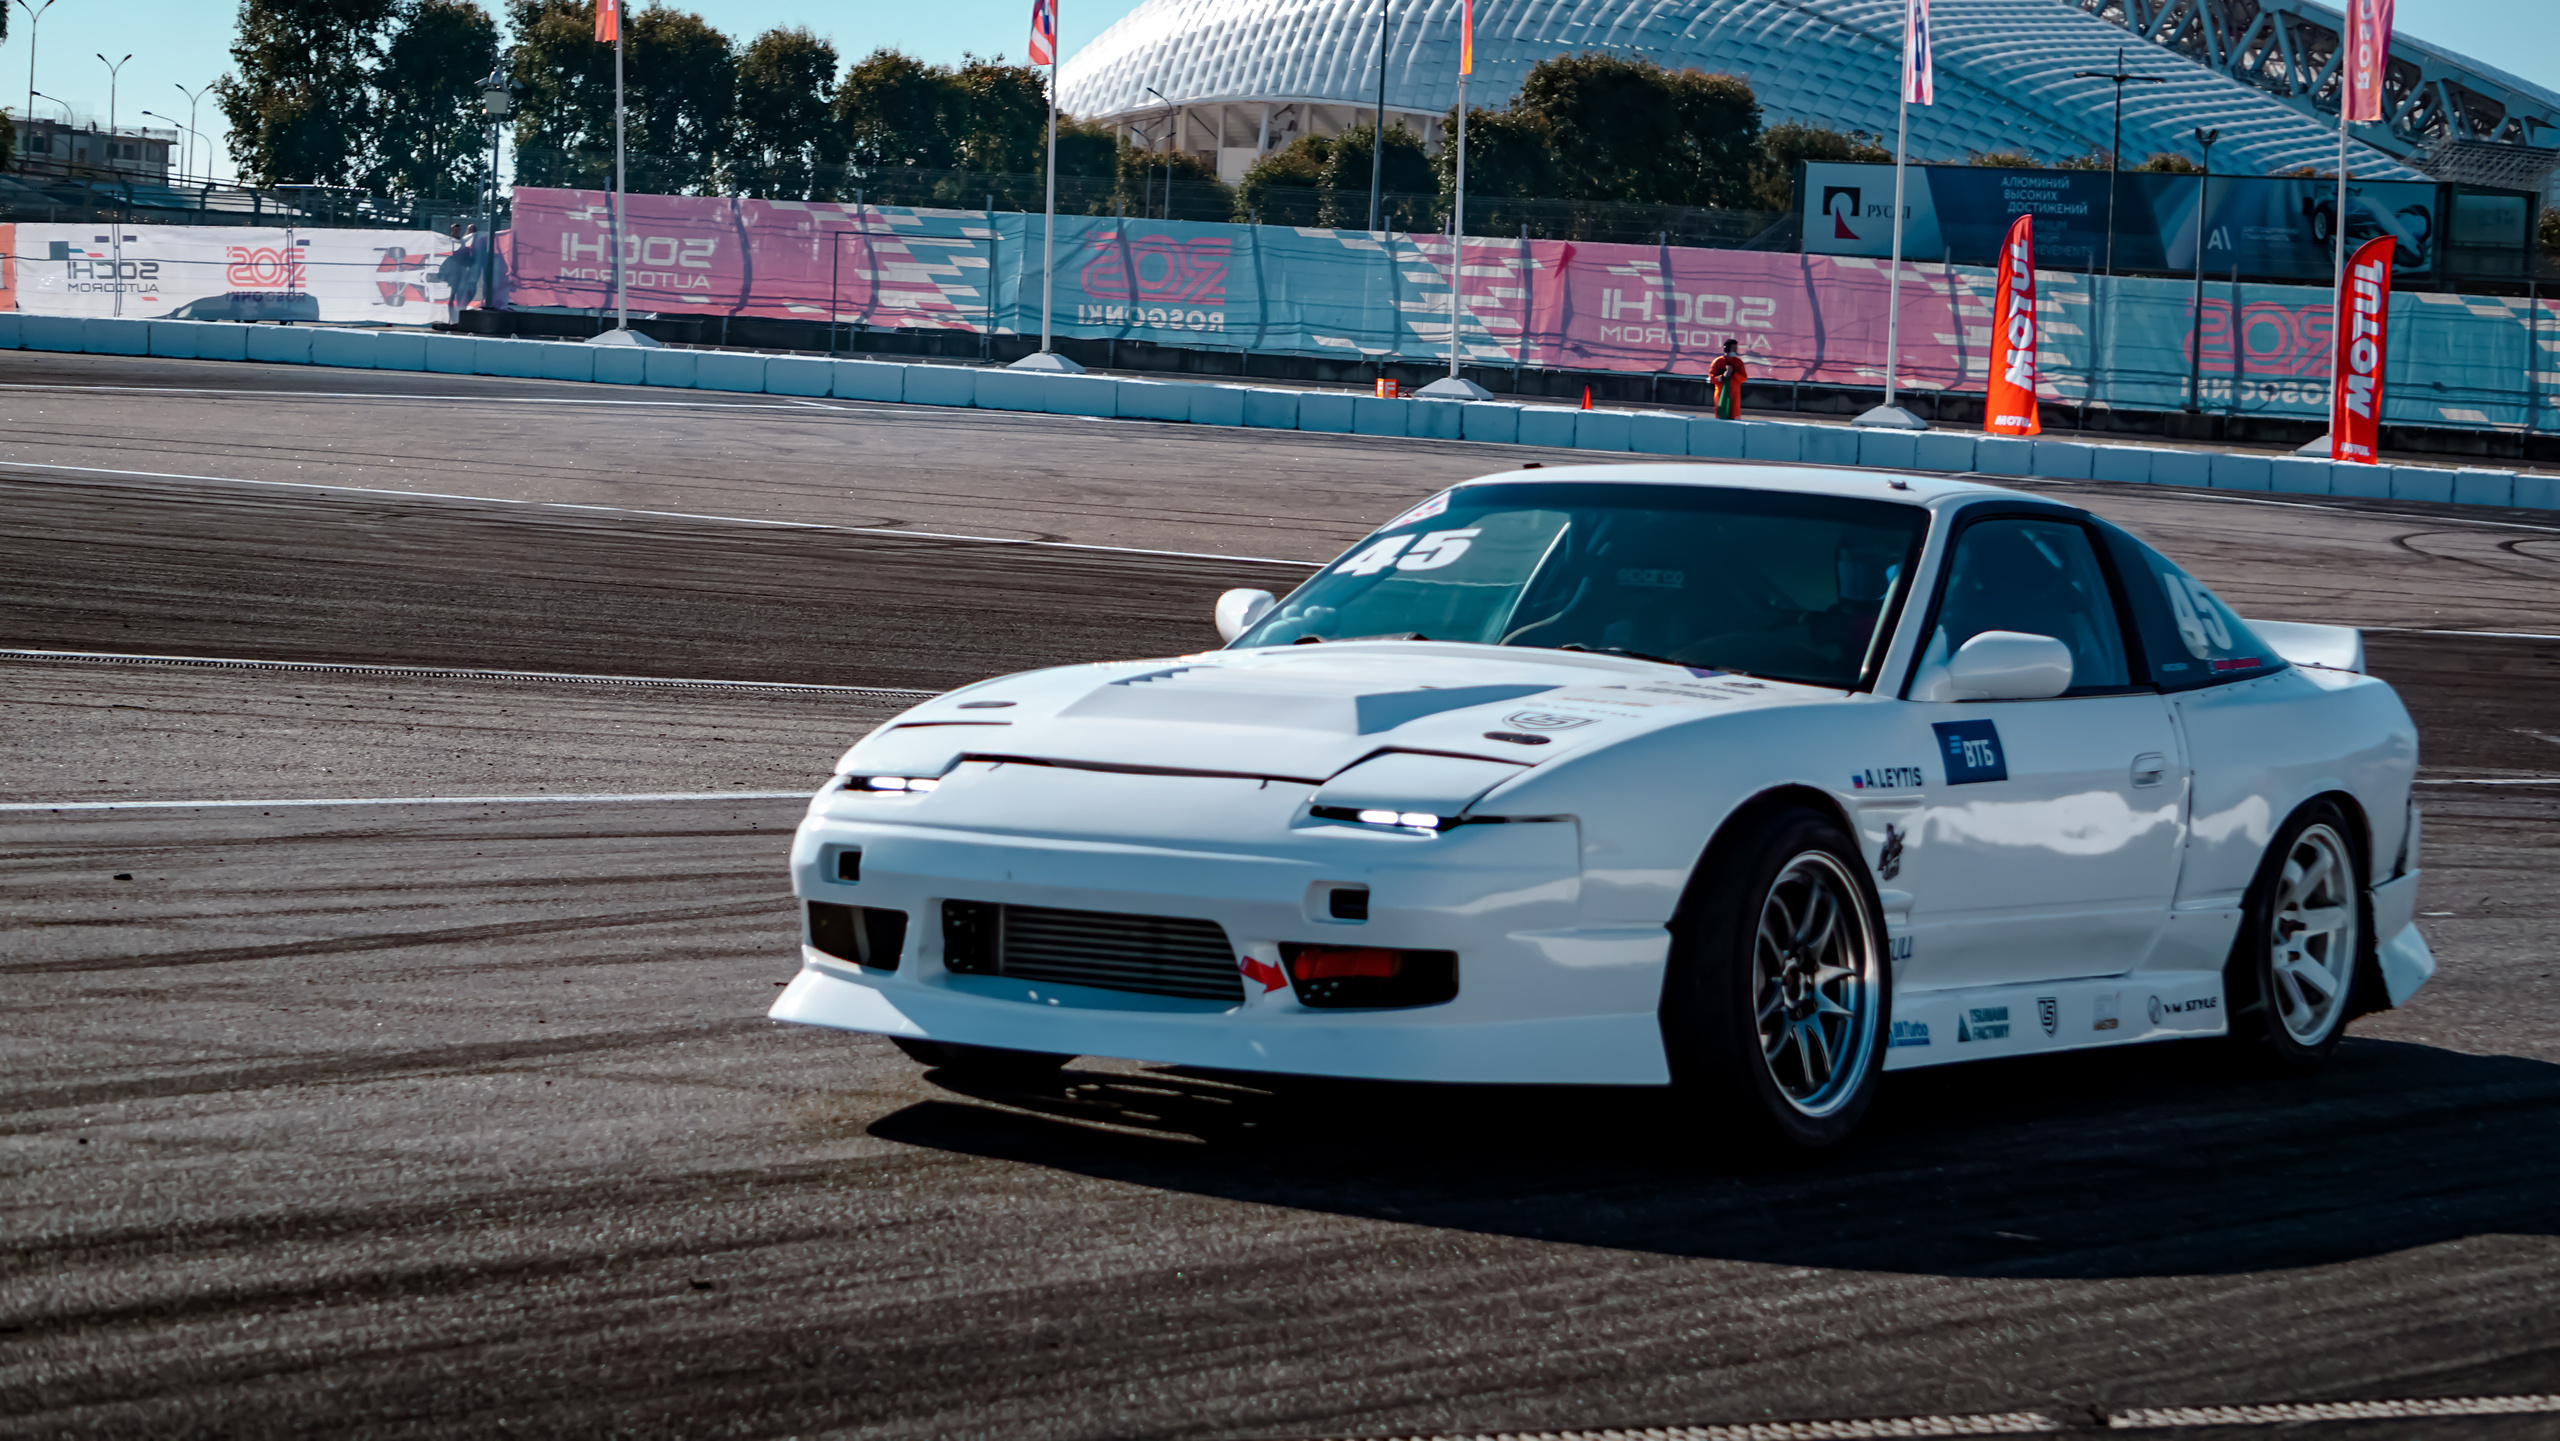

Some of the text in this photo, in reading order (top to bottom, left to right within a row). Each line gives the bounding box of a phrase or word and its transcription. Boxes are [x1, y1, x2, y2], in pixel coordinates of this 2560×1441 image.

[2001, 176, 2070, 189] АЛЮМИНИЙ
[2004, 189, 2058, 201] ВЫСОКИХ
[1867, 204, 1911, 220] РУСЛ
[2007, 202, 2088, 215] ДОСТИЖЕНИЙ
[2005, 238, 2034, 392] MOTUL
[2344, 259, 2384, 419] MOTUL
[1332, 528, 1482, 577] 45
[1616, 568, 1684, 586] sparco
[2163, 573, 2232, 660] 45
[1962, 739, 1995, 768] ВТБ
[1864, 767, 1923, 788] A.LEYTIS
[2185, 996, 2218, 1012] STYLE
